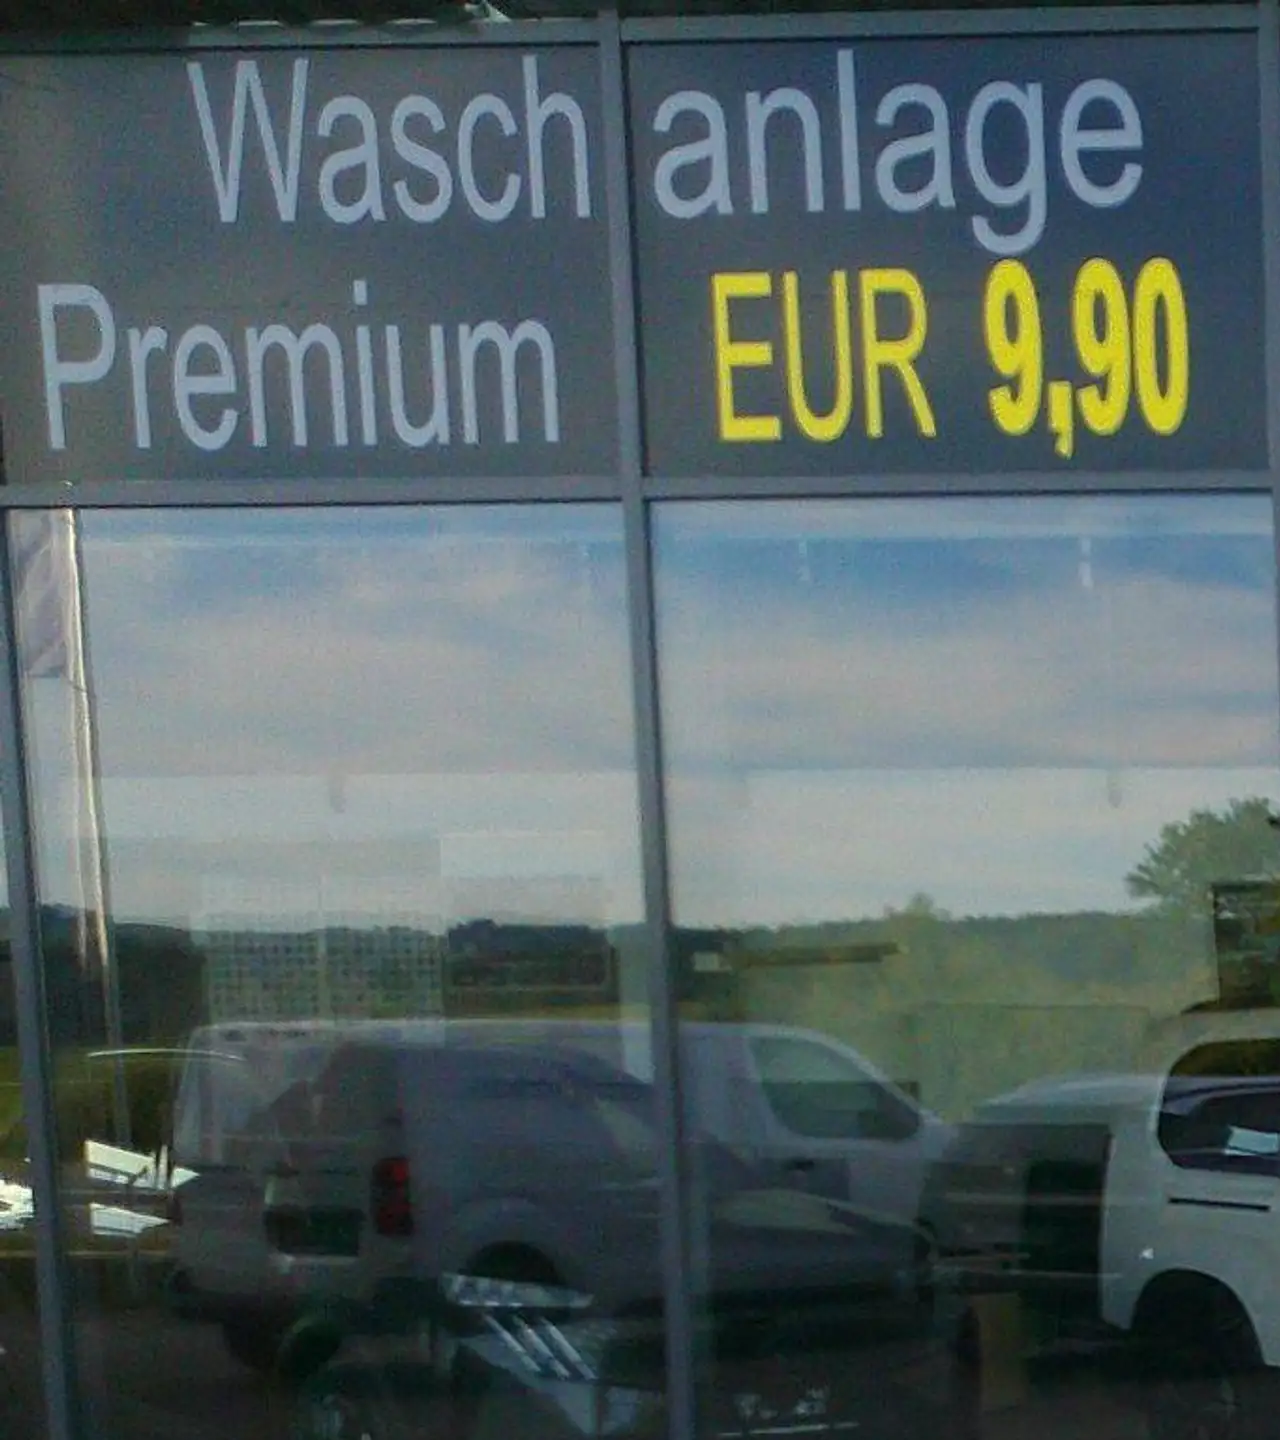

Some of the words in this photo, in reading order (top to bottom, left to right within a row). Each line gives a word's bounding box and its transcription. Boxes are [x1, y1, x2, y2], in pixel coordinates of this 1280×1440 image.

[36, 280, 561, 452] Premium
[710, 268, 937, 443] EUR
[983, 256, 1190, 459] 9,90
